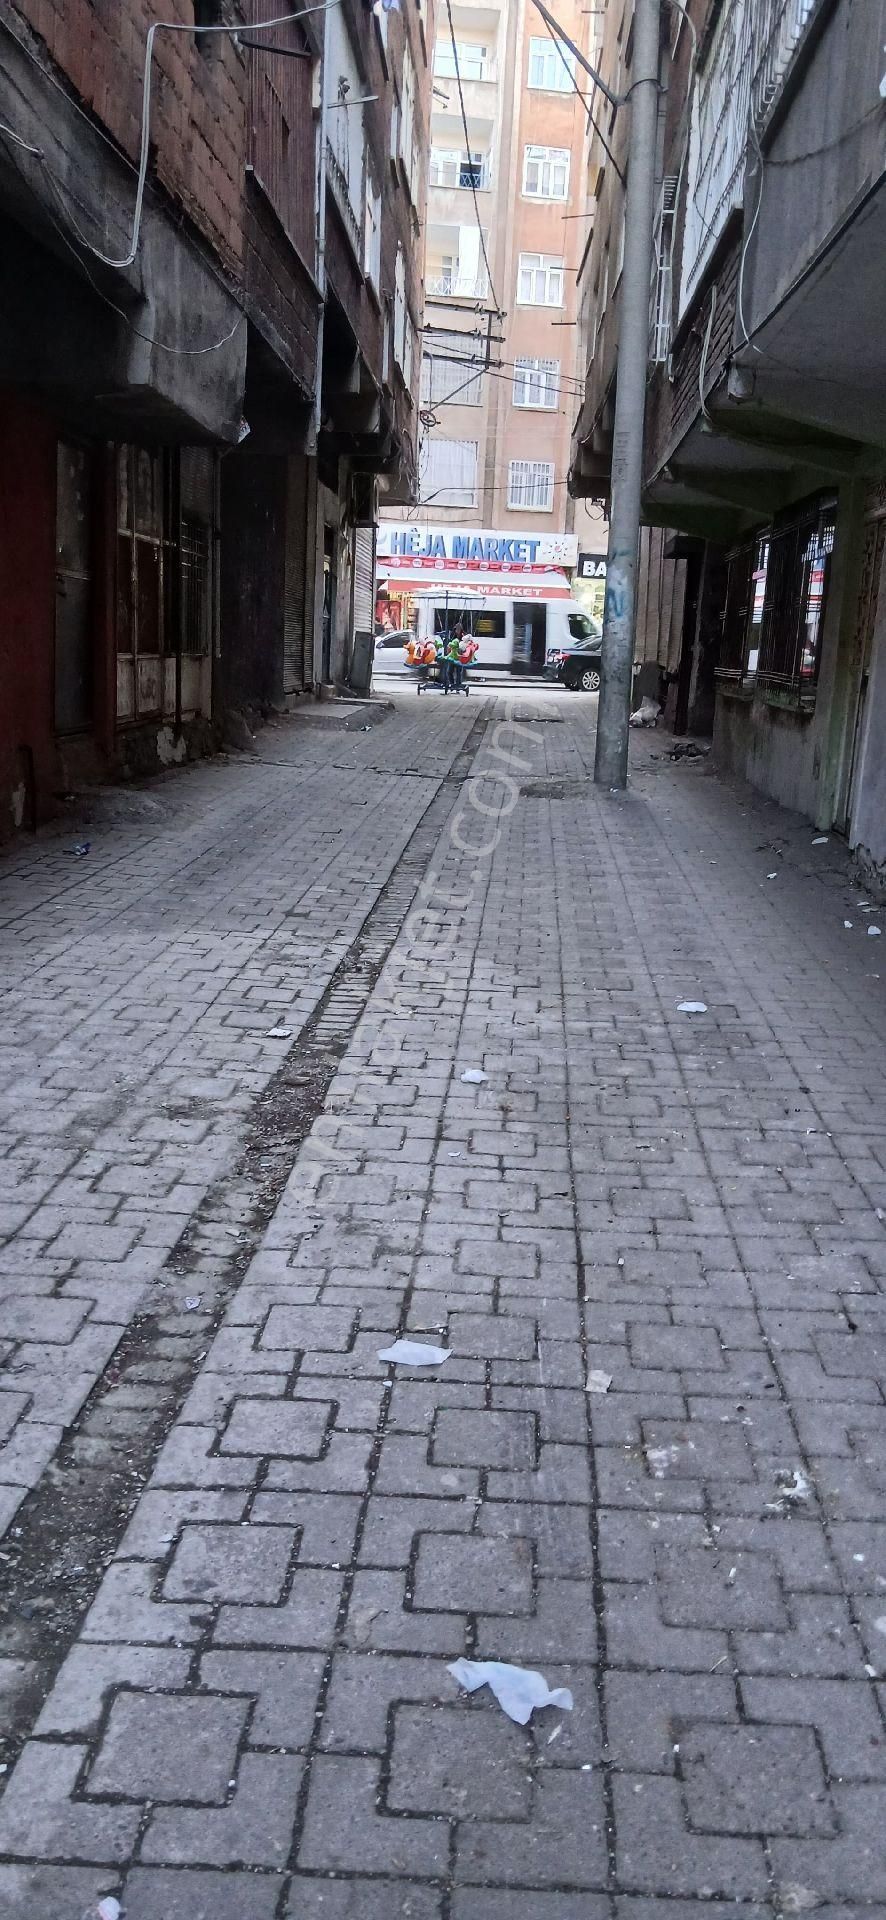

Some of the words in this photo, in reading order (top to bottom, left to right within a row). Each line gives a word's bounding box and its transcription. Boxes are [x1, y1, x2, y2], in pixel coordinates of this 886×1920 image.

[390, 528, 447, 558] HÊJA
[452, 535, 541, 562] MARKET
[477, 585, 543, 597] MARKET
